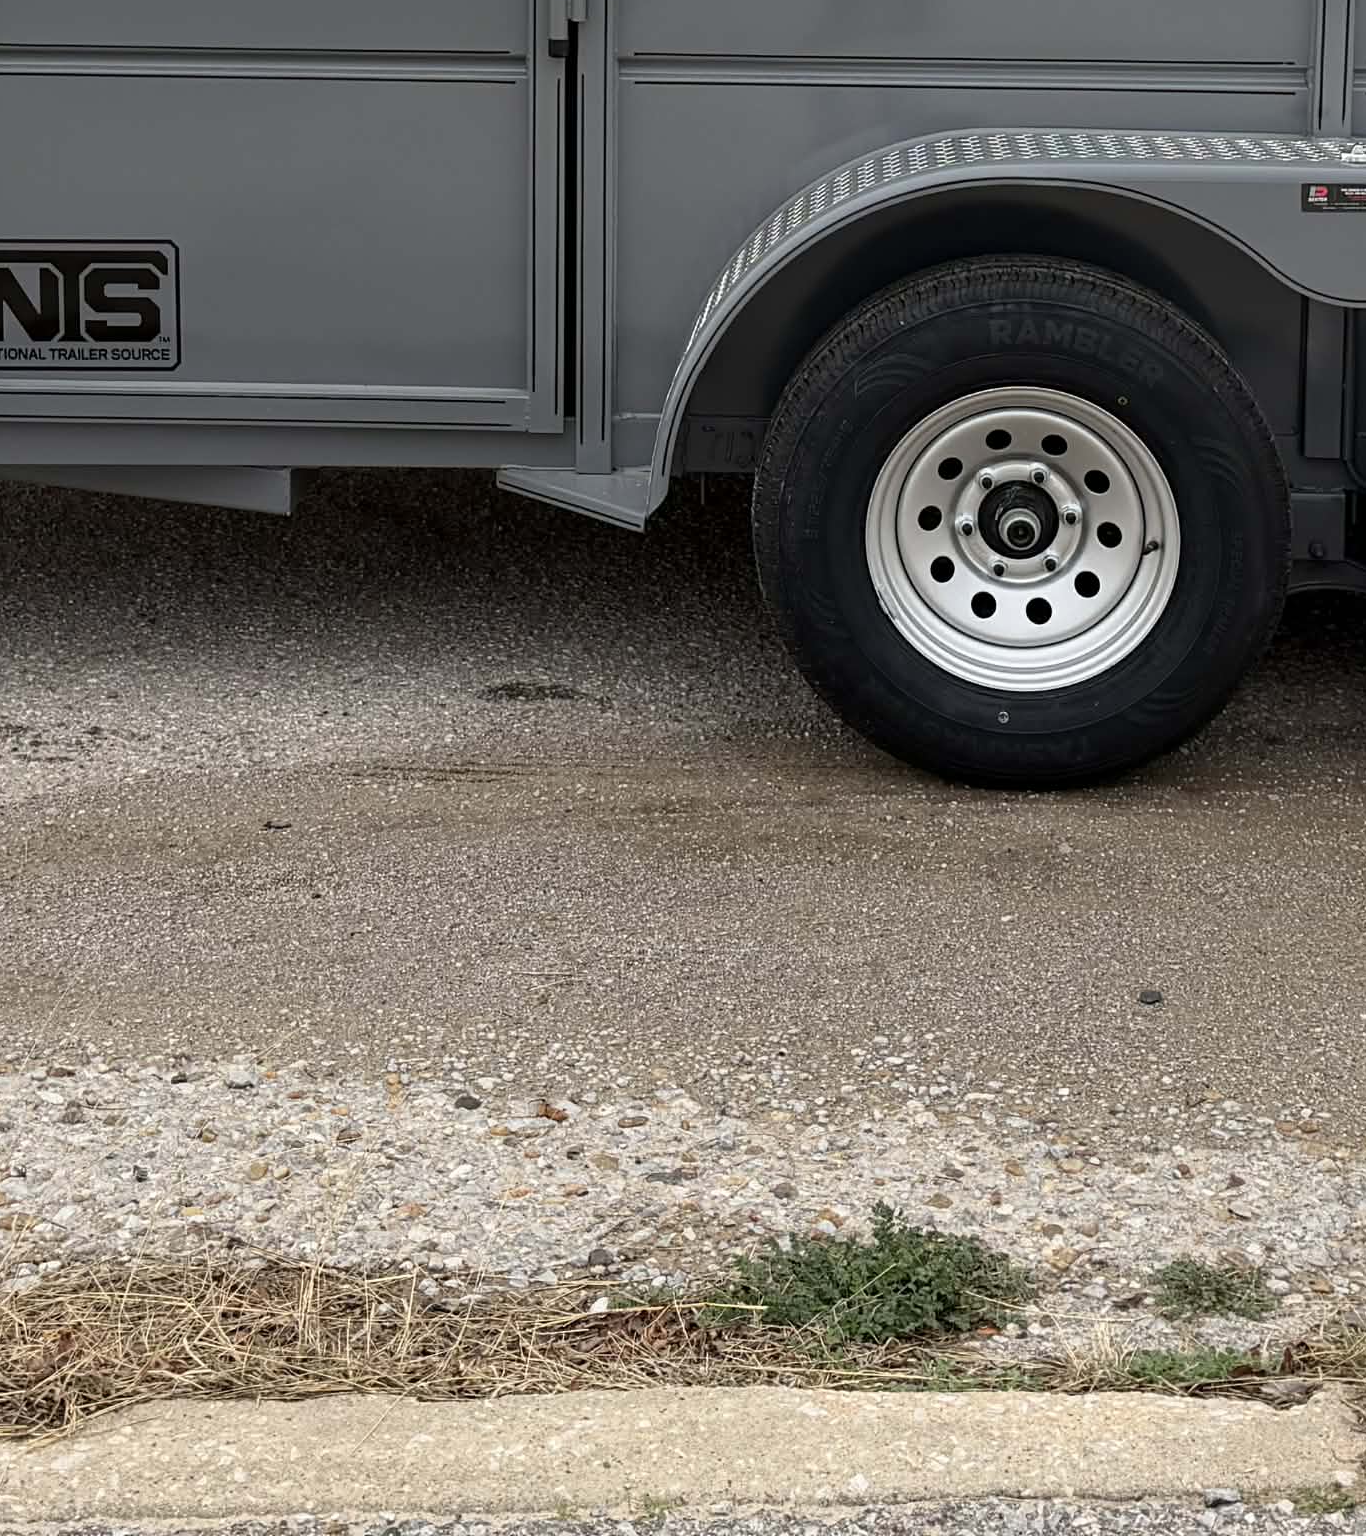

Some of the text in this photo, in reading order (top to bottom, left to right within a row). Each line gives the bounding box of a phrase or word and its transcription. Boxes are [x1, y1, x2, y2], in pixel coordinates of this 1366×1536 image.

[48, 348, 108, 361] TRAILER
[111, 348, 171, 361] SOURCE
[987, 318, 1166, 389] RAMBLER
